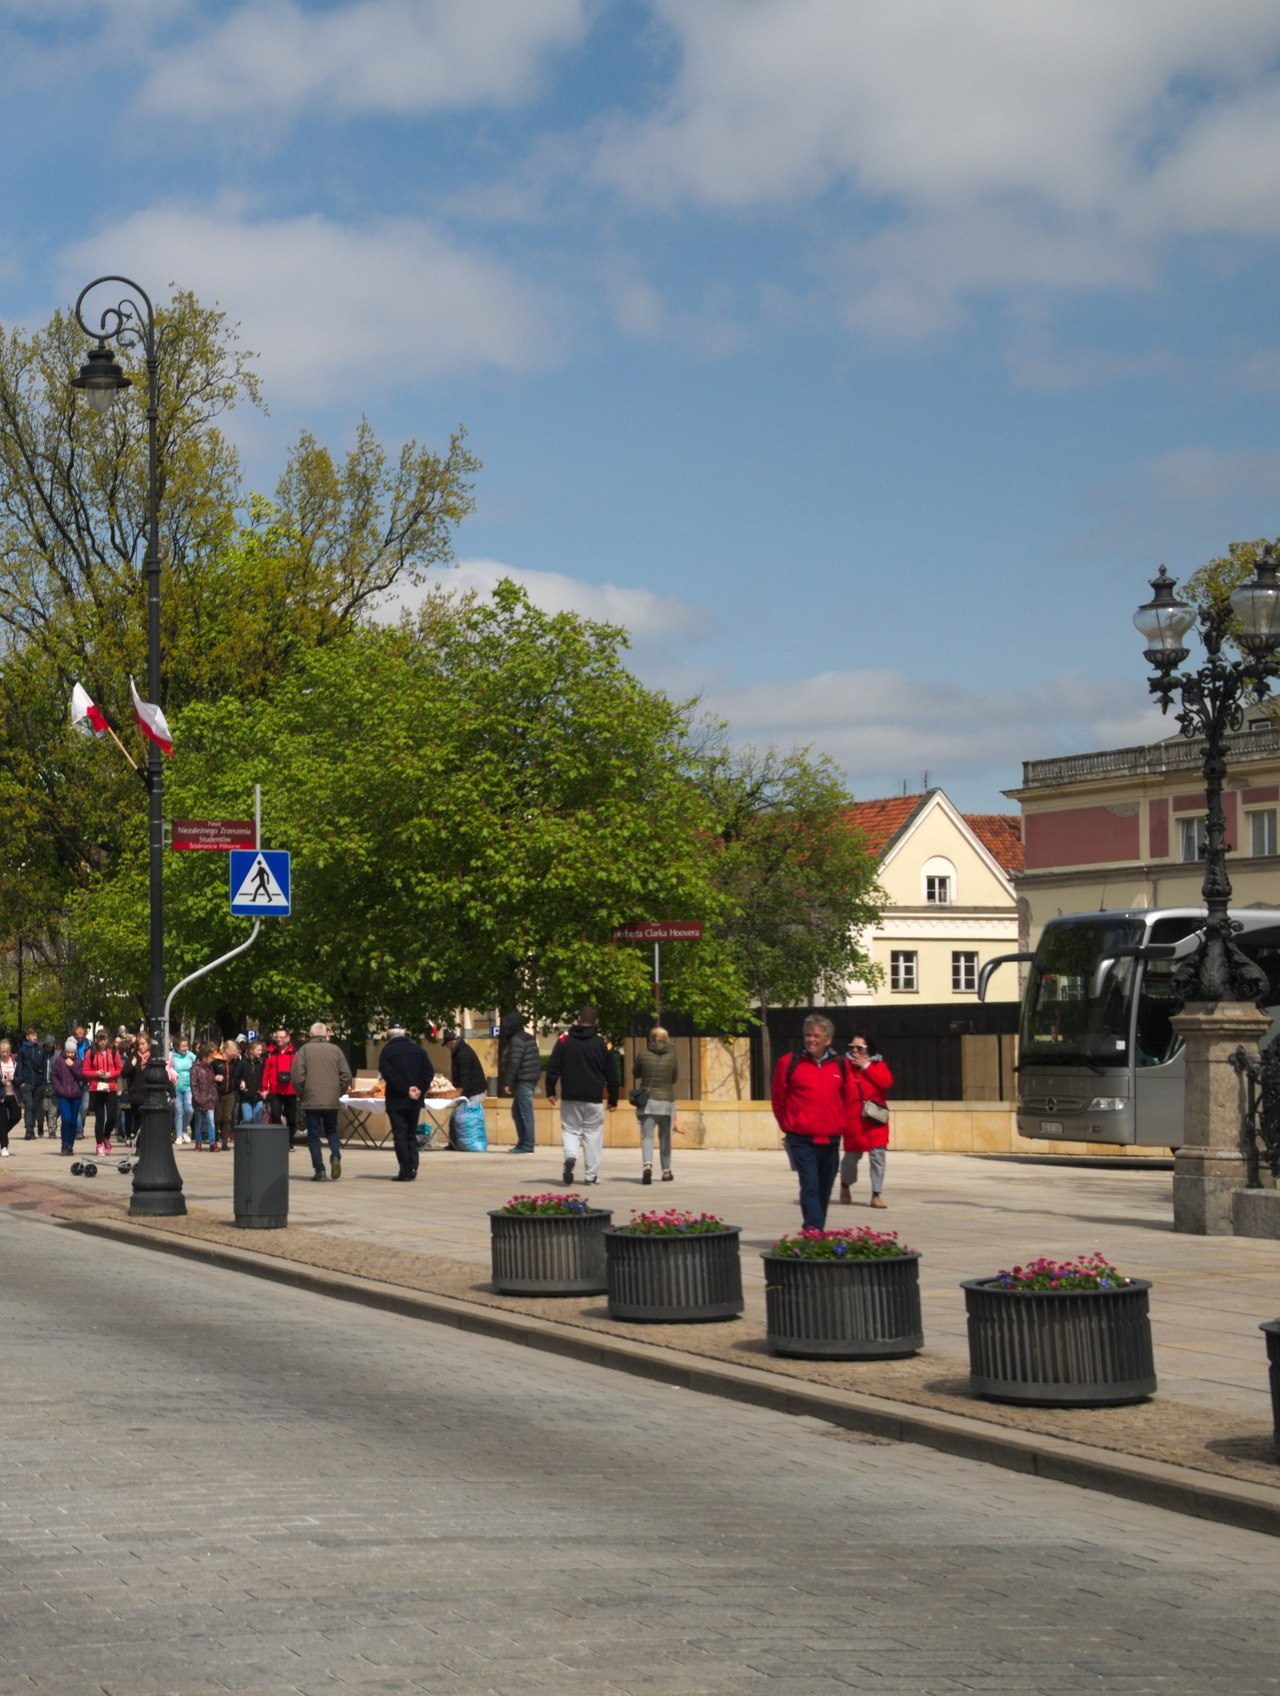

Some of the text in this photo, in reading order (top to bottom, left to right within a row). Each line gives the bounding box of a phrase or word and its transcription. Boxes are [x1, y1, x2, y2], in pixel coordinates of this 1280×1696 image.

[178, 826, 218, 837] Niezależnego
[644, 928, 668, 937] Clarka
[669, 928, 700, 937] Hoovera
